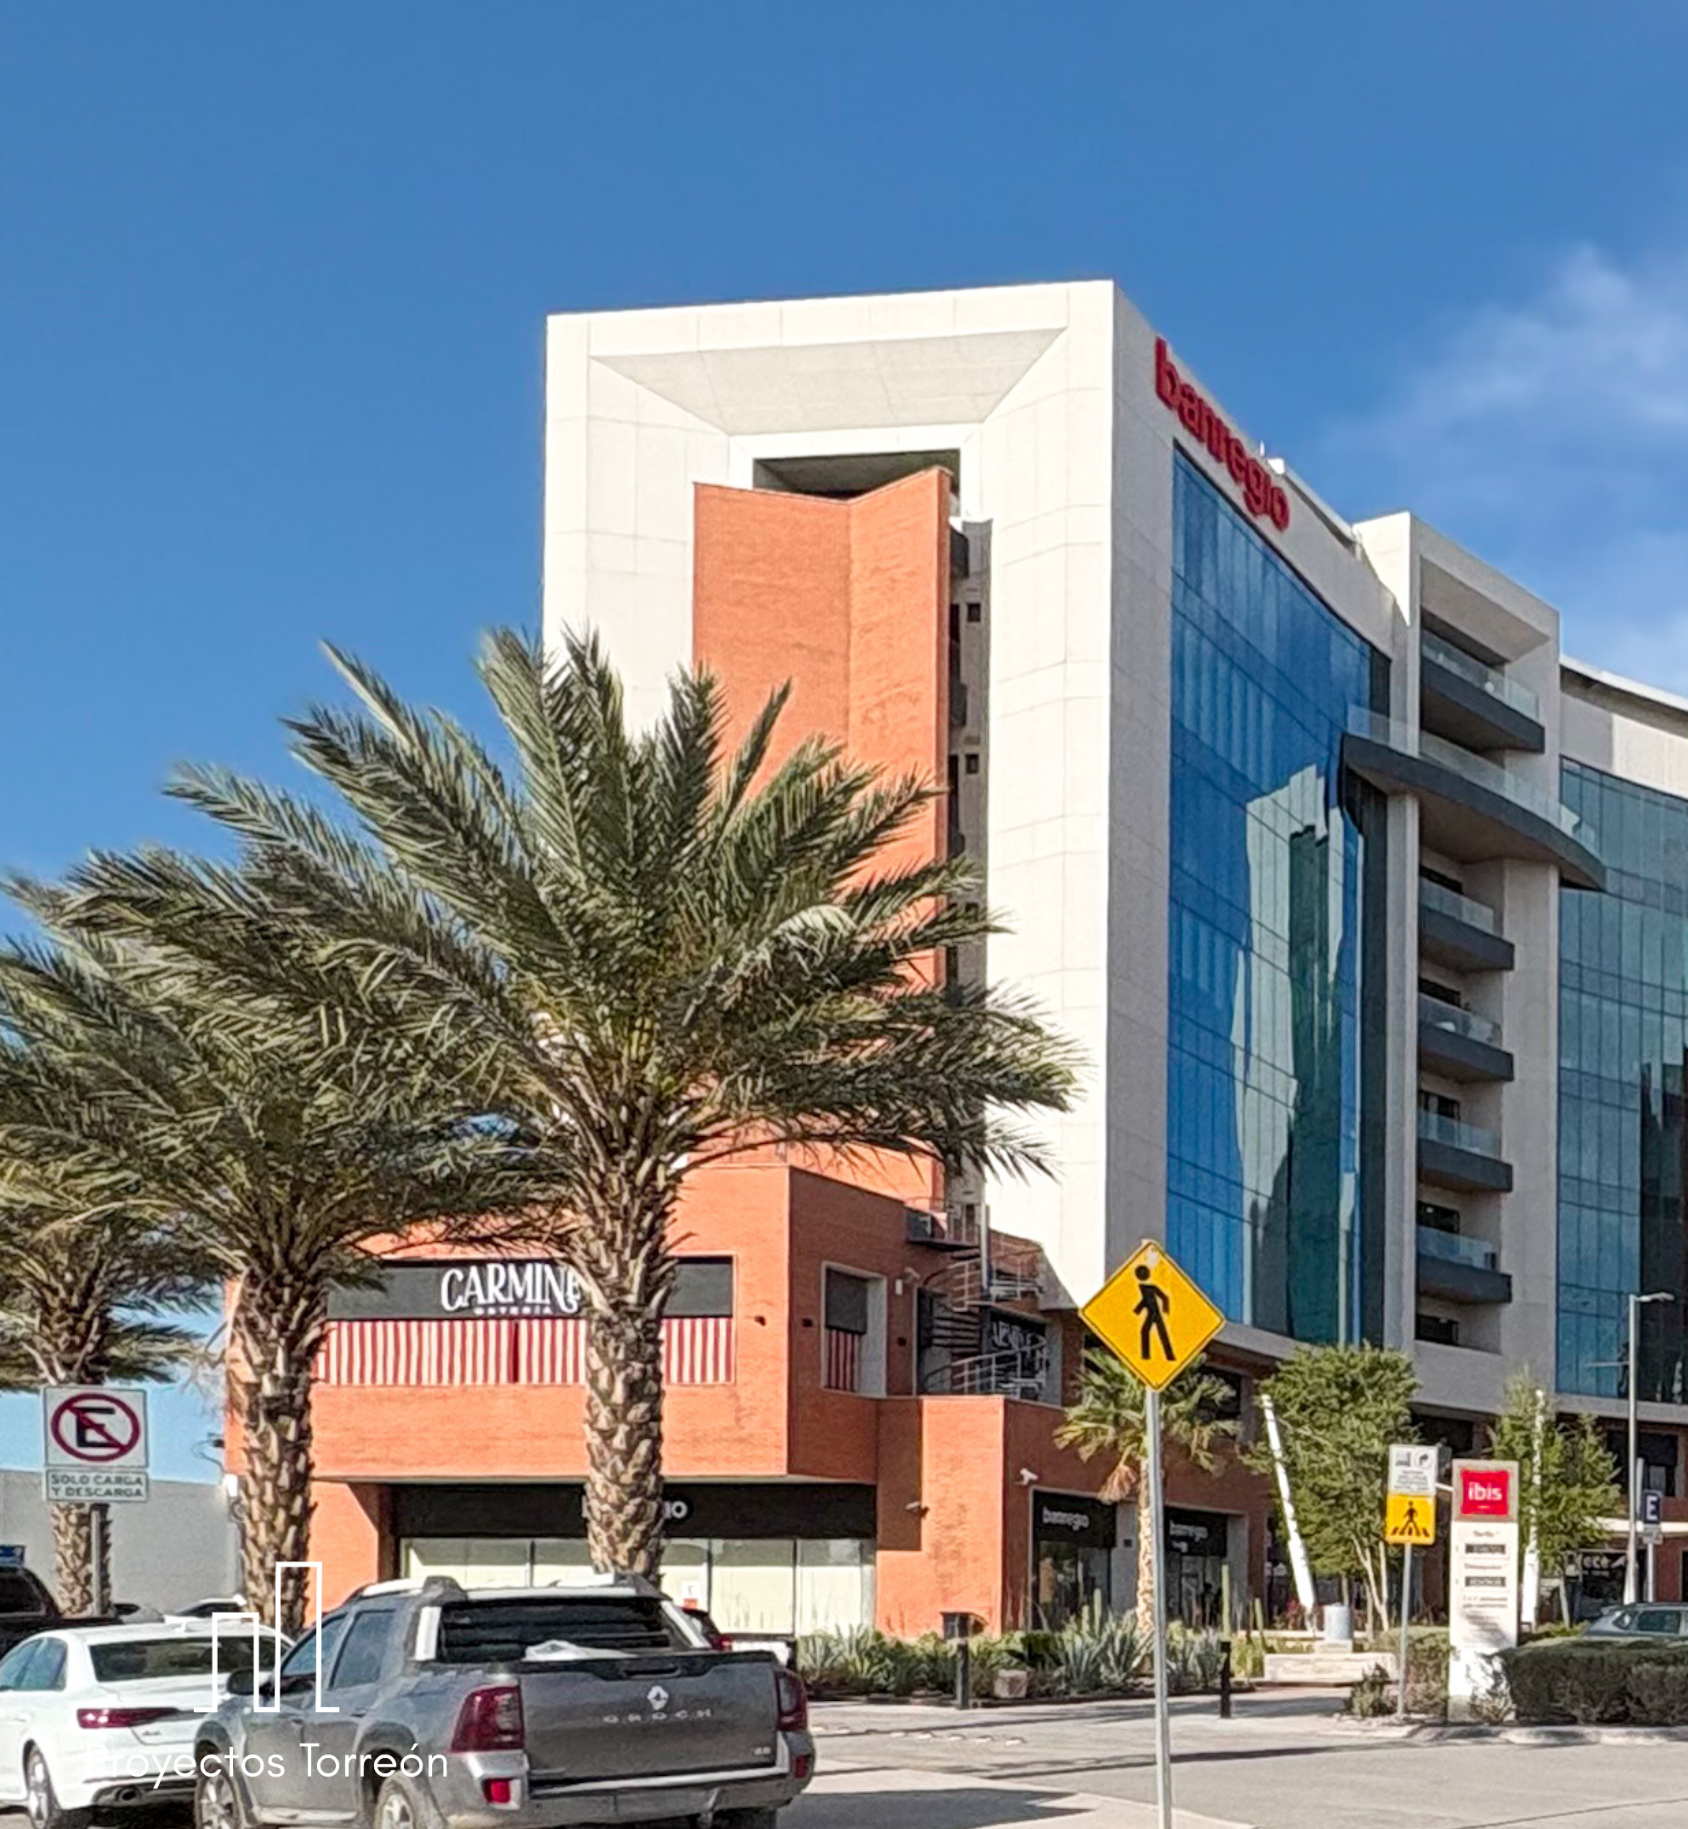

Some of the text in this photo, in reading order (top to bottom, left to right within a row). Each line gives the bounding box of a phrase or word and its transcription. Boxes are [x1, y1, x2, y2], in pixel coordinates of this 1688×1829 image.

[1154, 336, 1290, 533] banregio
[50, 1474, 143, 1487] SOLO CARGA
[50, 1487, 143, 1498] Y DESCARGA
[1467, 1481, 1503, 1502] ibis
